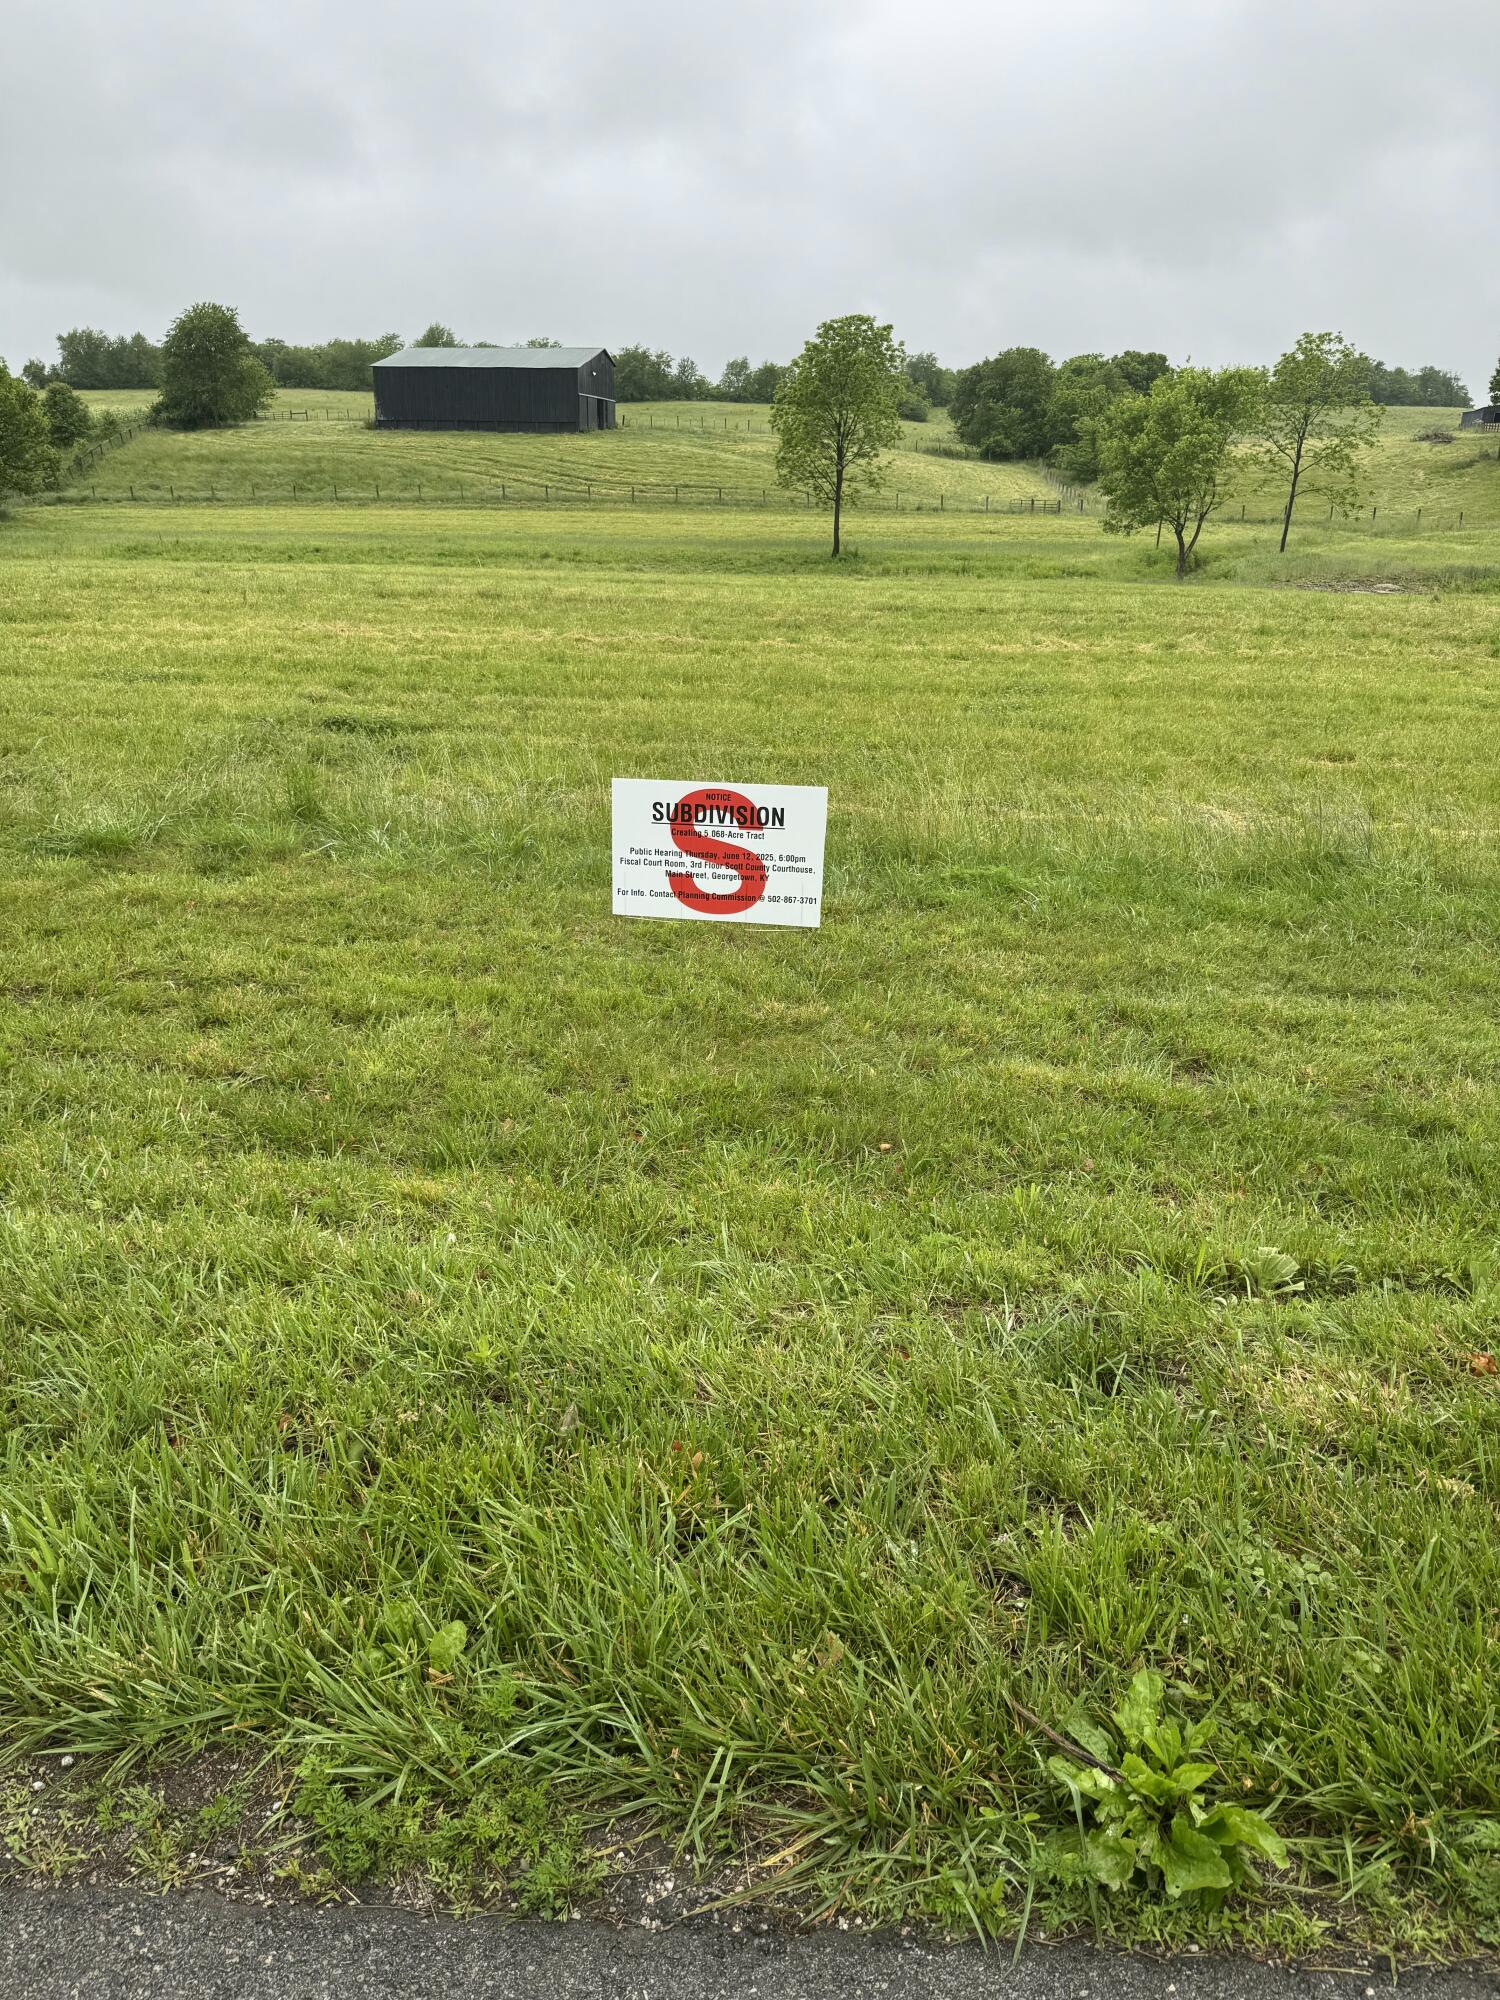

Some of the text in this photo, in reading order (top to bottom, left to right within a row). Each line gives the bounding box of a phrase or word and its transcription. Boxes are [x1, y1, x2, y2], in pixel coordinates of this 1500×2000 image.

[705, 793, 731, 802] NOTICE
[652, 801, 785, 827] SUBDIVISION
[671, 828, 702, 838] Creating
[746, 831, 765, 840] Tract
[629, 847, 806, 863] Public Hearing Thursday, June 12, 2025, 6:00pm
[619, 857, 816, 875] Fiscal Court Room, 3rd Floor Scott County Courthouse,
[665, 869, 770, 882] Main Street, Georgetown, KY
[617, 888, 629, 897] For
[630, 889, 647, 898] Info.
[649, 890, 676, 899] Contact
[678, 891, 710, 901] Planning
[711, 893, 757, 902] Commission
[767, 895, 818, 905] 502-867-3701
